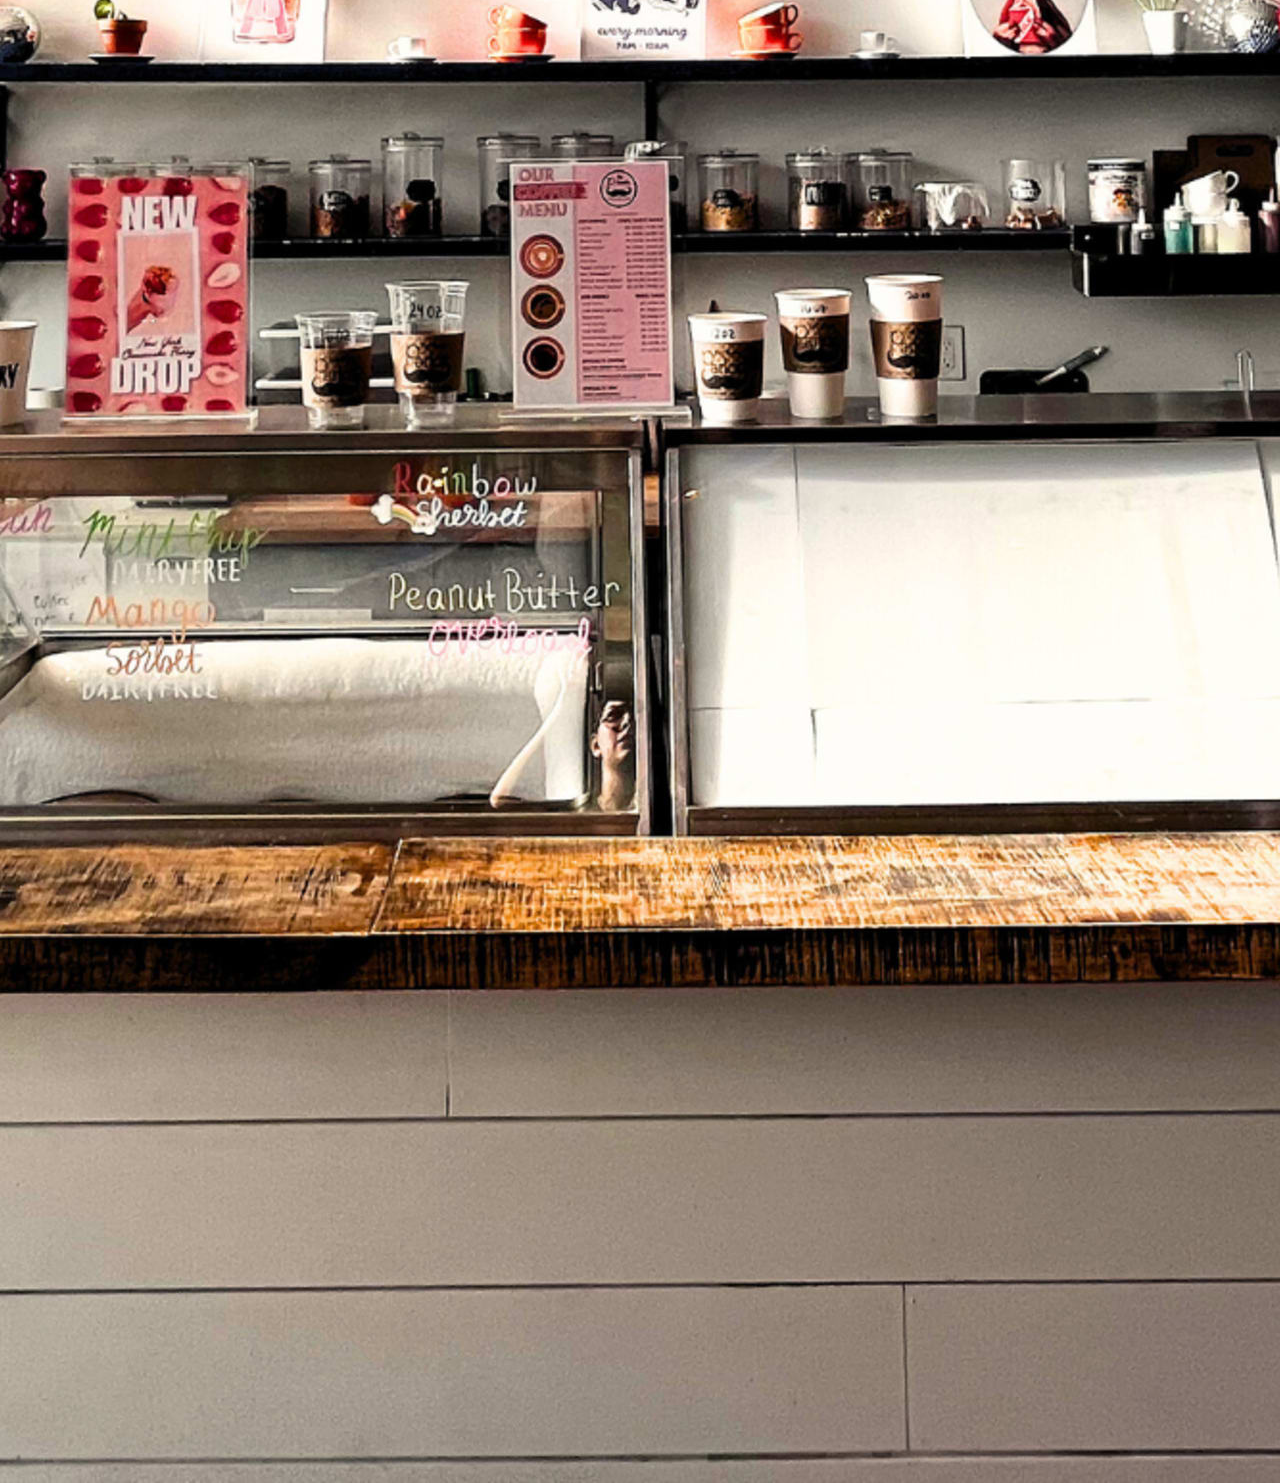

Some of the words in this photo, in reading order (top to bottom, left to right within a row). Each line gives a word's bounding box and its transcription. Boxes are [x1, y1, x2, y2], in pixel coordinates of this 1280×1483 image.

[597, 27, 632, 40] every
[635, 27, 687, 40] morning
[520, 169, 555, 182] OUR
[120, 196, 197, 230] NEW
[520, 203, 568, 217] MENU
[140, 337, 157, 348] New
[162, 337, 182, 347] York
[111, 358, 201, 394] DROP
[393, 461, 537, 497] Rainbow
[416, 496, 528, 527] Sherbet
[388, 572, 495, 611] Peanut
[503, 568, 621, 612] Butter
[86, 596, 216, 627] Mango
[429, 616, 591, 656] Overload
[106, 636, 202, 676] Sorbet
